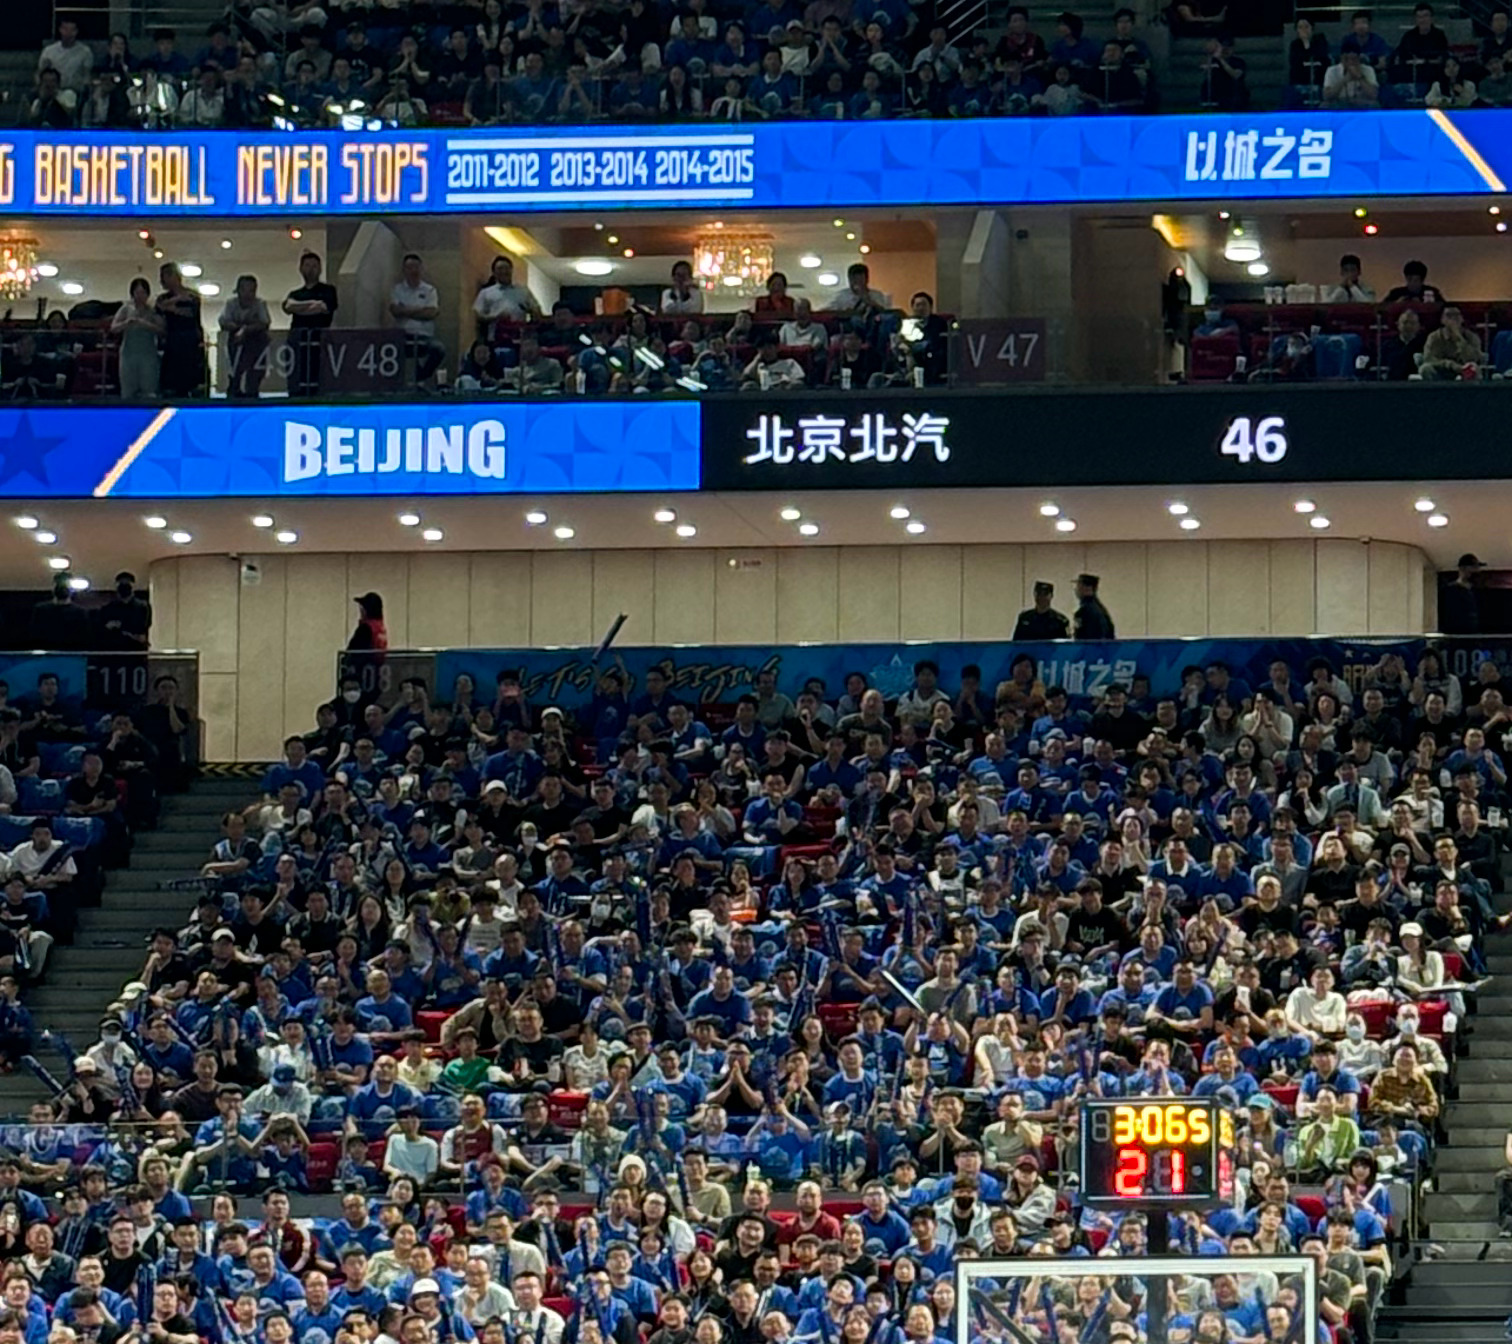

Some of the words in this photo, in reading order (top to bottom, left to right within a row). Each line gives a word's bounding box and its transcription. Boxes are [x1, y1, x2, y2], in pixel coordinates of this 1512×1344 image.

[35, 144, 214, 205] BASKETBALL
[237, 144, 328, 205] NEVER
[341, 143, 430, 204] STOPS
[447, 153, 540, 188] 2011-2012
[550, 151, 648, 186] 2013-2014
[655, 149, 754, 184] 2014-2015
[1185, 128, 1333, 181] 以城之名
[253, 344, 295, 378] 49
[327, 343, 346, 378] V
[357, 343, 399, 377] 48
[967, 334, 987, 367] V
[997, 333, 1039, 366] 47
[285, 420, 506, 483] BEIJING
[745, 414, 950, 466] 北京北汽
[1220, 416, 1288, 463] 46
[1114, 1147, 1186, 1199] 21
